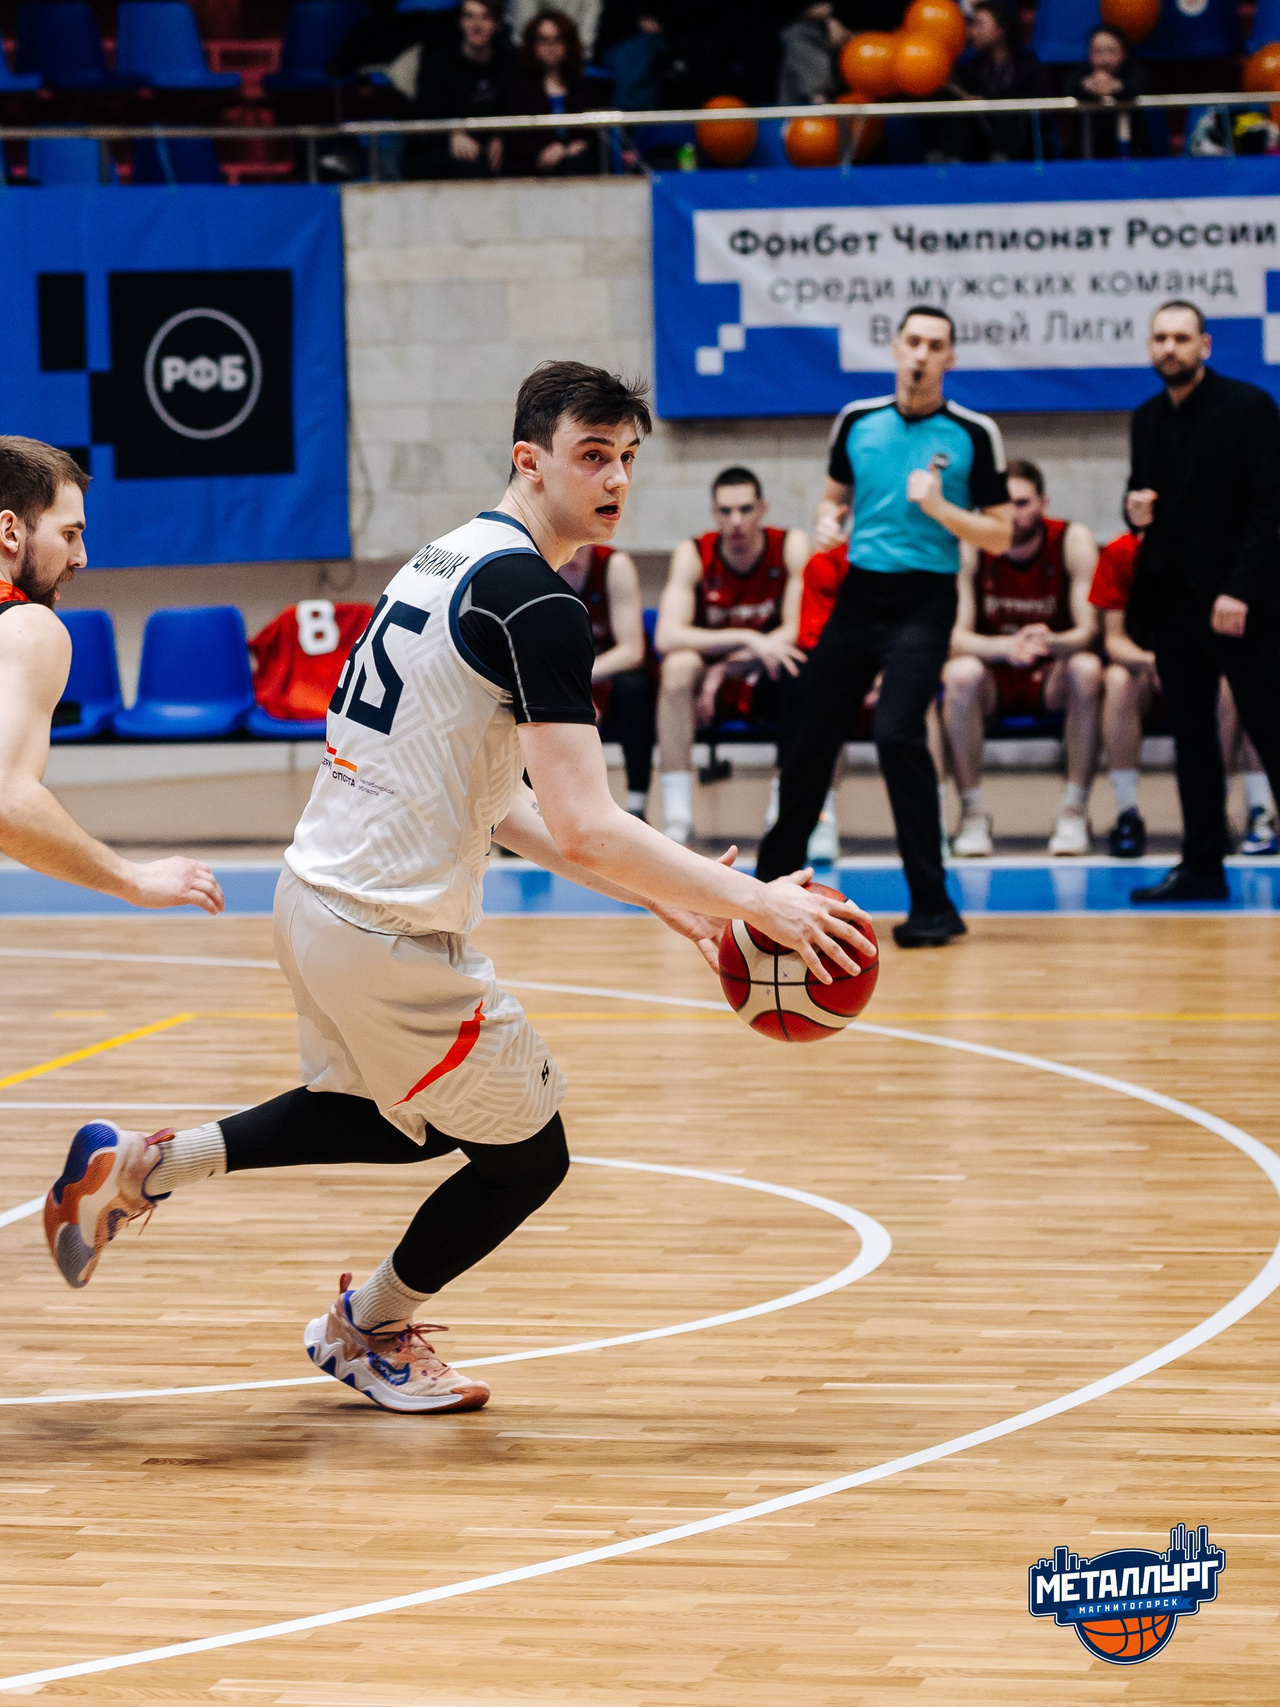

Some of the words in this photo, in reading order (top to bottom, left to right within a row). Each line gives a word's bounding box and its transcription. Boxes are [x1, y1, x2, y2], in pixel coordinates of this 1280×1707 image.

[728, 222, 881, 258] Фонбет
[892, 223, 1113, 253] Чемпионат
[1126, 217, 1278, 248] России
[769, 275, 896, 312] среди
[907, 271, 1076, 308] мужских
[1089, 266, 1238, 298] команд
[870, 310, 1031, 348] Вшей
[1043, 309, 1136, 344] Лиги
[161, 353, 248, 394] РФБ
[296, 599, 340, 656] 8
